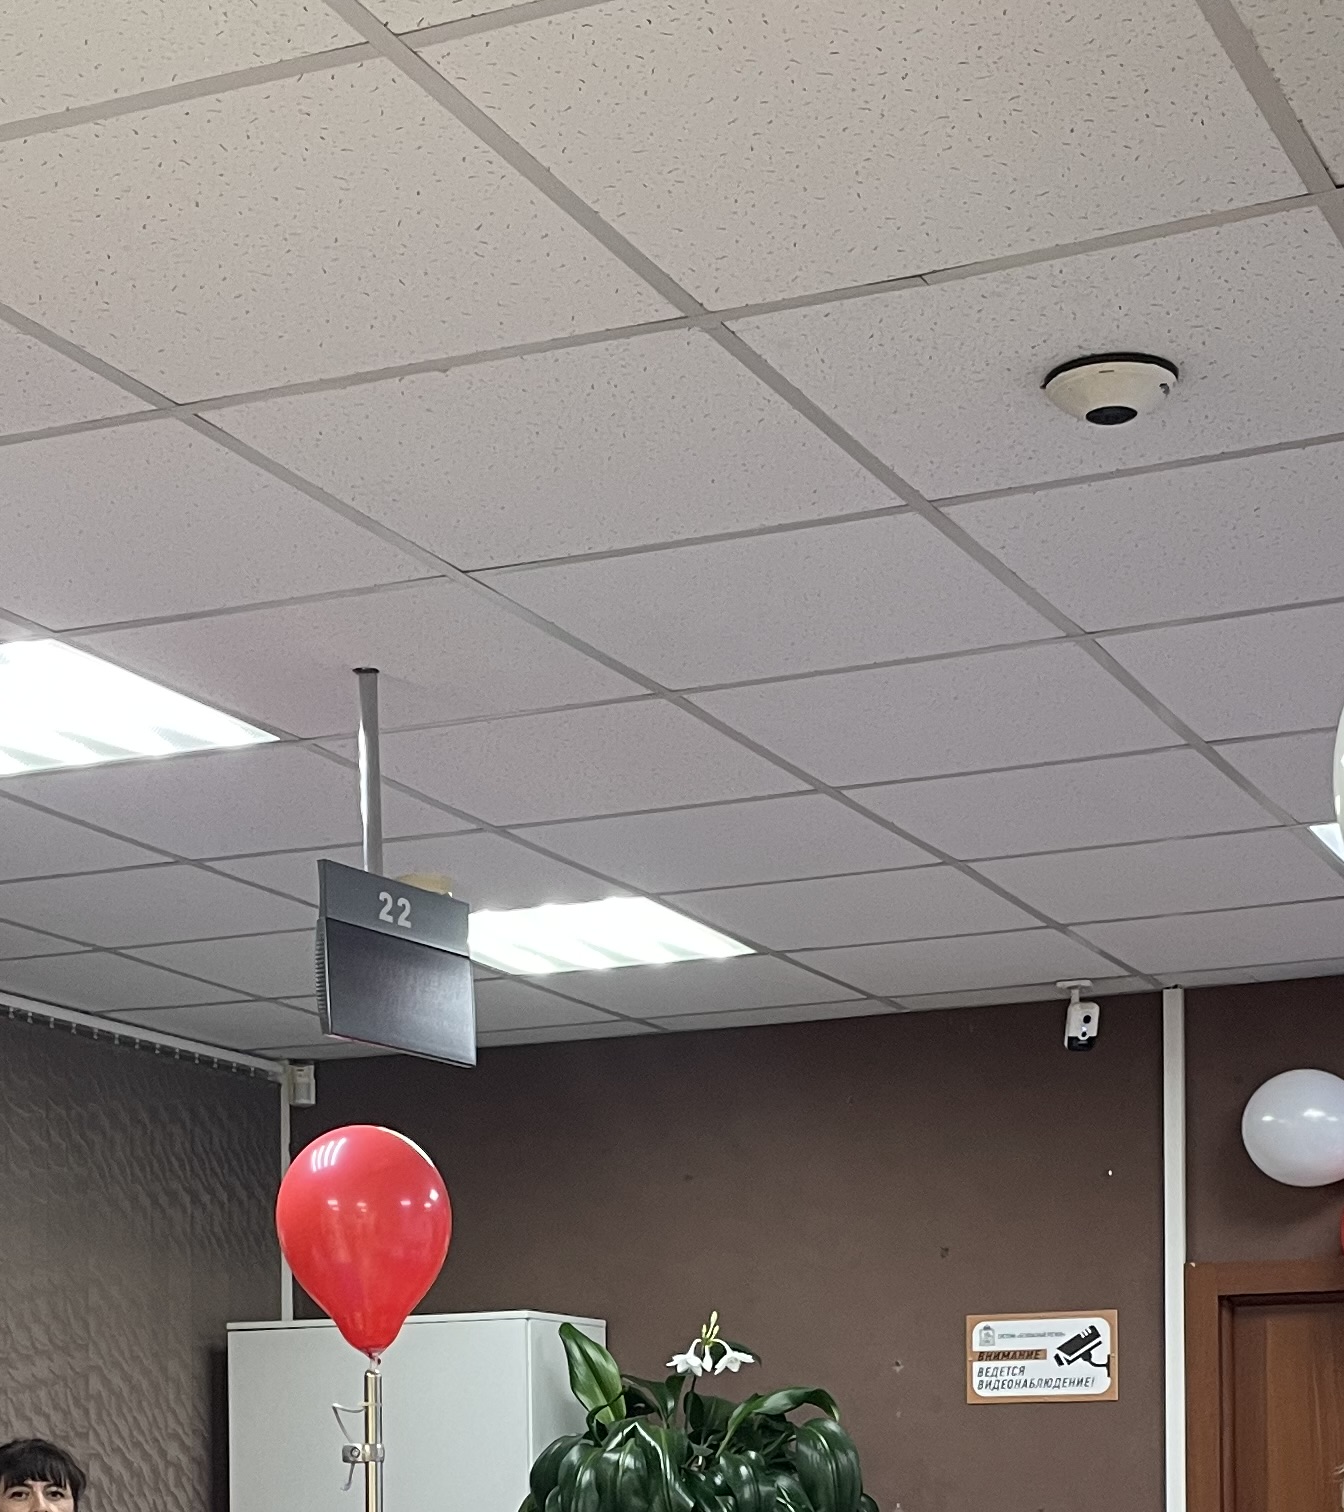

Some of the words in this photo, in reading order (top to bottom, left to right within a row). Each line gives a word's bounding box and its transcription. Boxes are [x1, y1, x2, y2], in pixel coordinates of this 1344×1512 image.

[378, 891, 412, 929] 22
[977, 1349, 1042, 1361] ВНИМАНИЕ
[977, 1366, 1026, 1378] ВЕДЕТСЯ
[977, 1377, 1096, 1391] ВИДЕОНАБЛЮДЕНИЕ!
